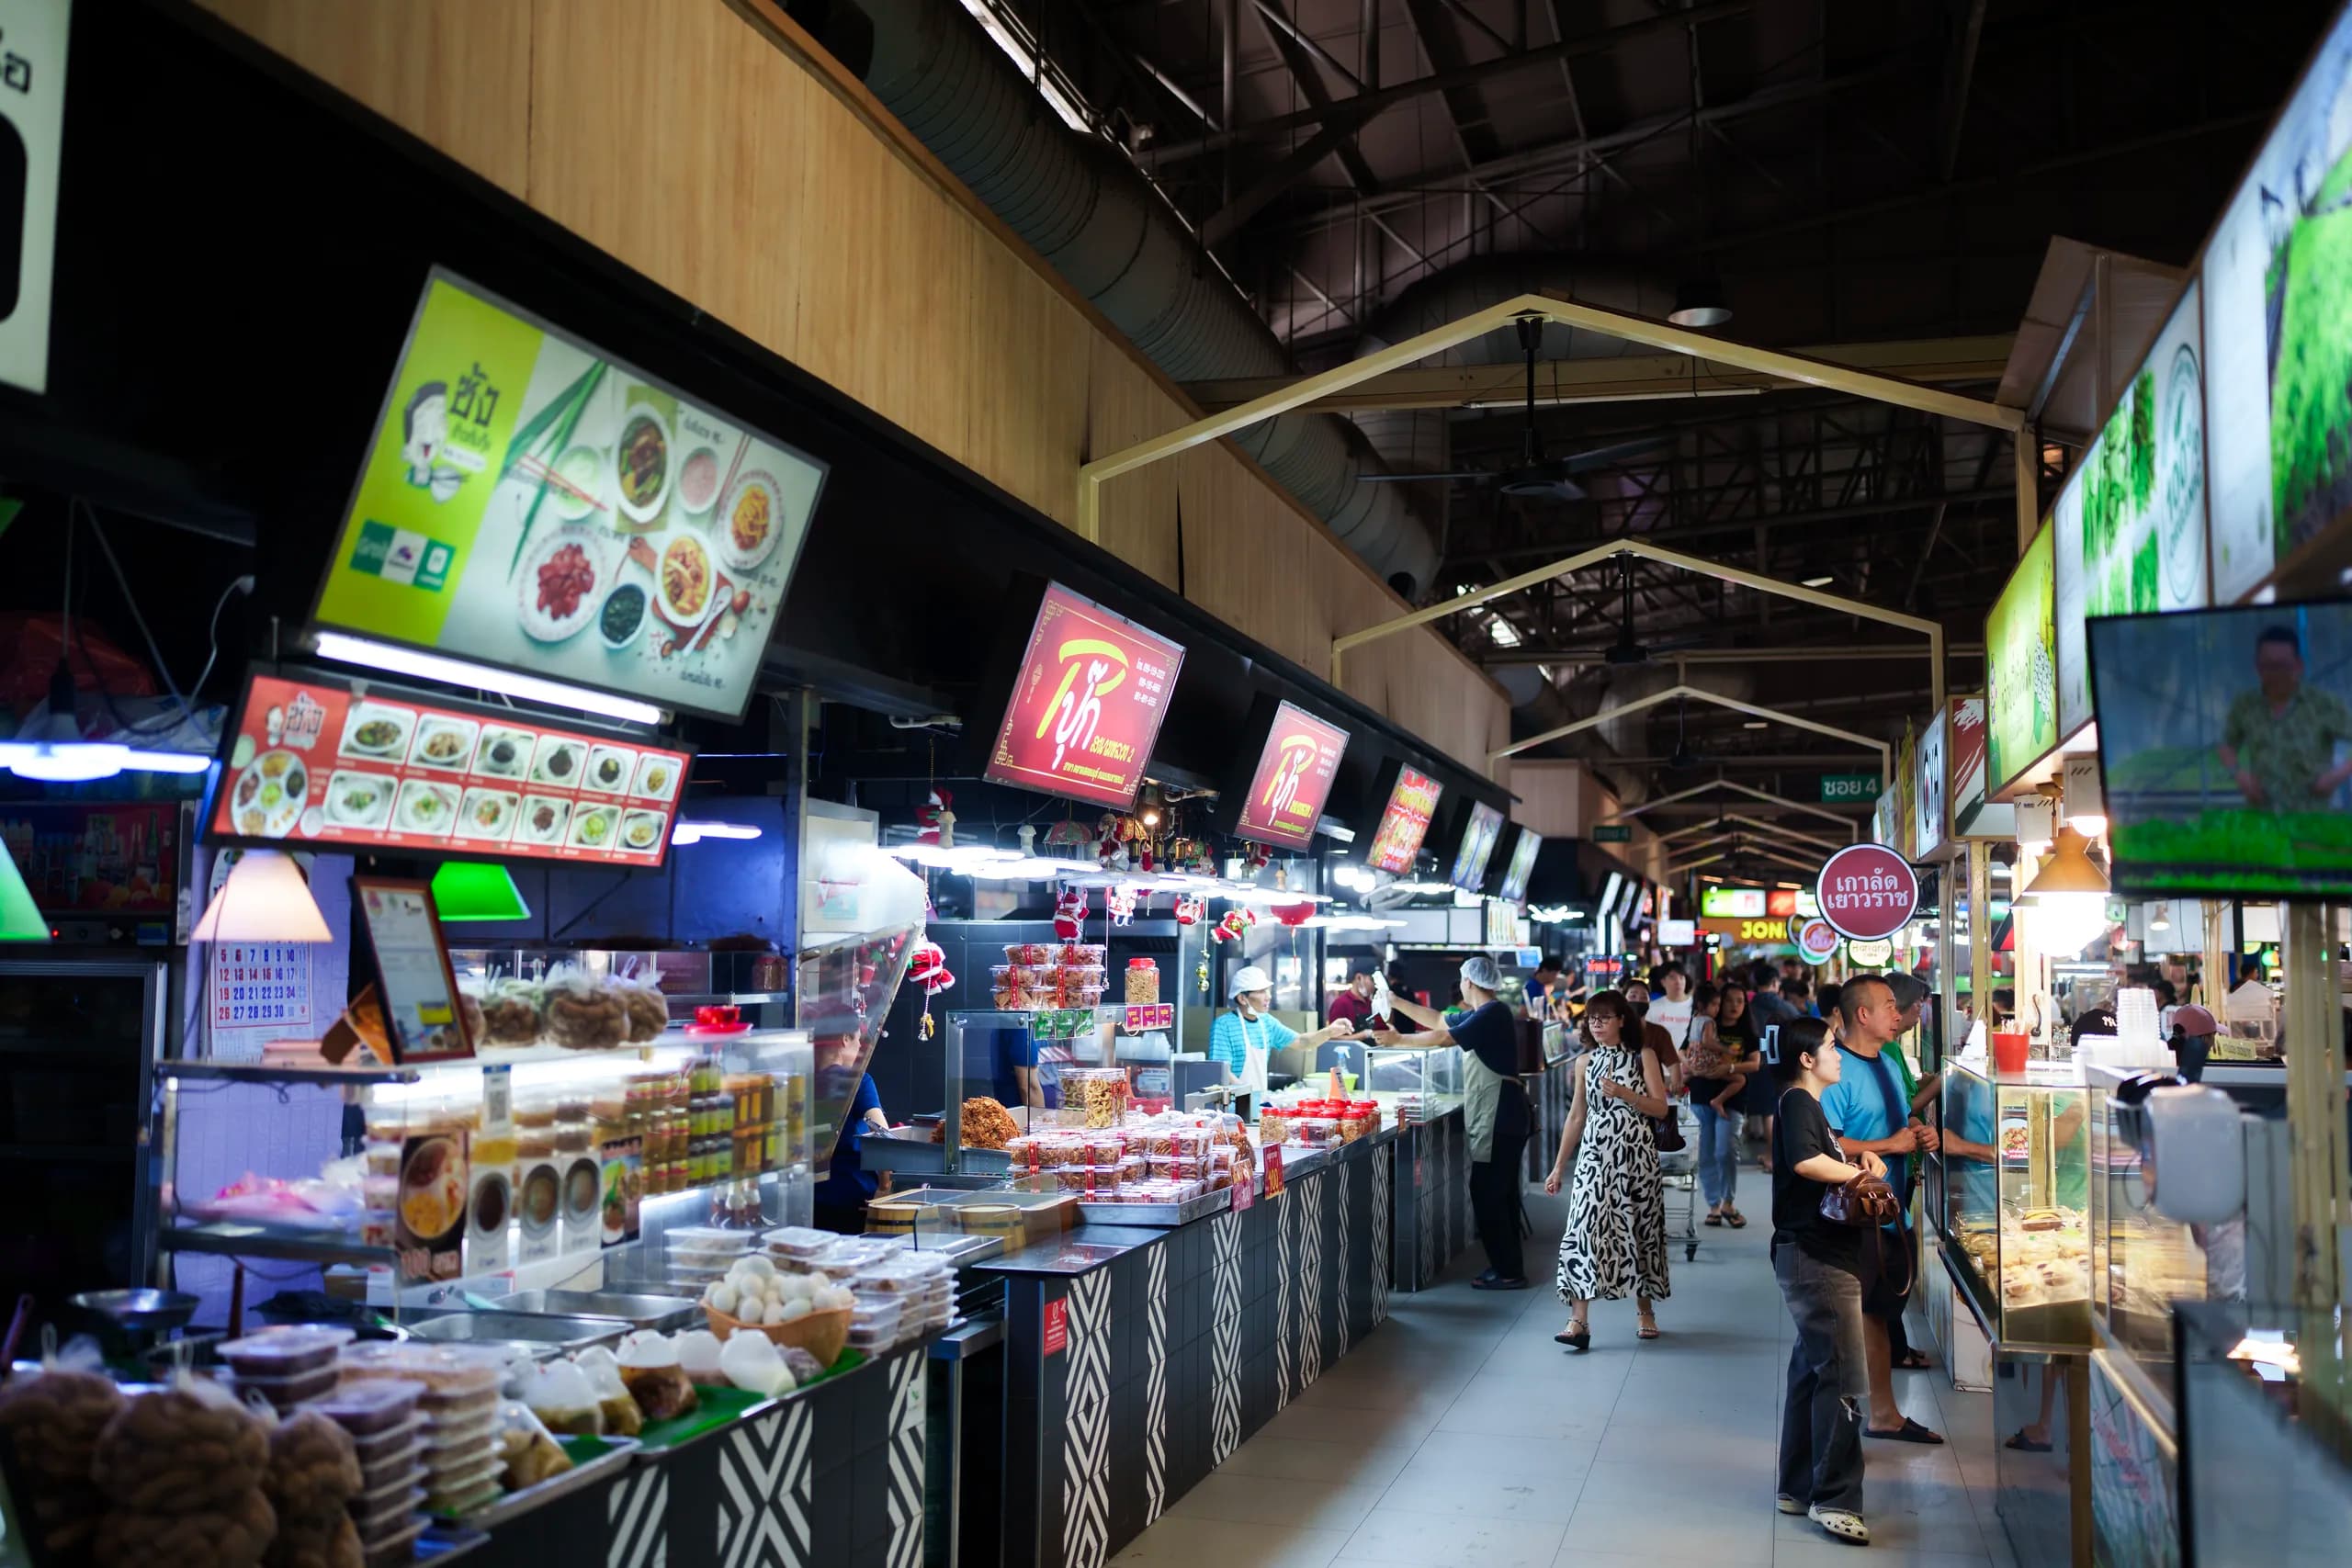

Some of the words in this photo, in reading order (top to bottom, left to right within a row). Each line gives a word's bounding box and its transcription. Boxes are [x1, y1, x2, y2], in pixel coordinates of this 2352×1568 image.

[1824, 779, 1861, 796] ซอย
[1865, 778, 1878, 795] 4
[1836, 867, 1899, 893] เกาลัด
[1826, 891, 1909, 909] เยาวราช
[1741, 920, 1787, 940] JON
[221, 949, 226, 962] 5
[250, 949, 255, 962] 7
[264, 949, 269, 962] 8
[277, 949, 281, 962] 9
[287, 948, 295, 962] 10
[220, 968, 229, 981] 12
[234, 968, 243, 981] 13
[249, 968, 258, 981] 14
[263, 968, 271, 980] 15
[276, 967, 283, 980] 16
[287, 967, 295, 980] 17
[220, 987, 229, 1000] 19
[234, 987, 244, 1000] 20
[249, 987, 258, 999] 21
[262, 987, 271, 999] 22
[275, 987, 283, 998] 23
[287, 986, 295, 998] 24
[220, 1007, 230, 1020] 26
[234, 1006, 244, 1020] 27
[248, 1005, 258, 1019] 28
[263, 1005, 272, 1018] 29
[275, 1005, 284, 1017] 30
